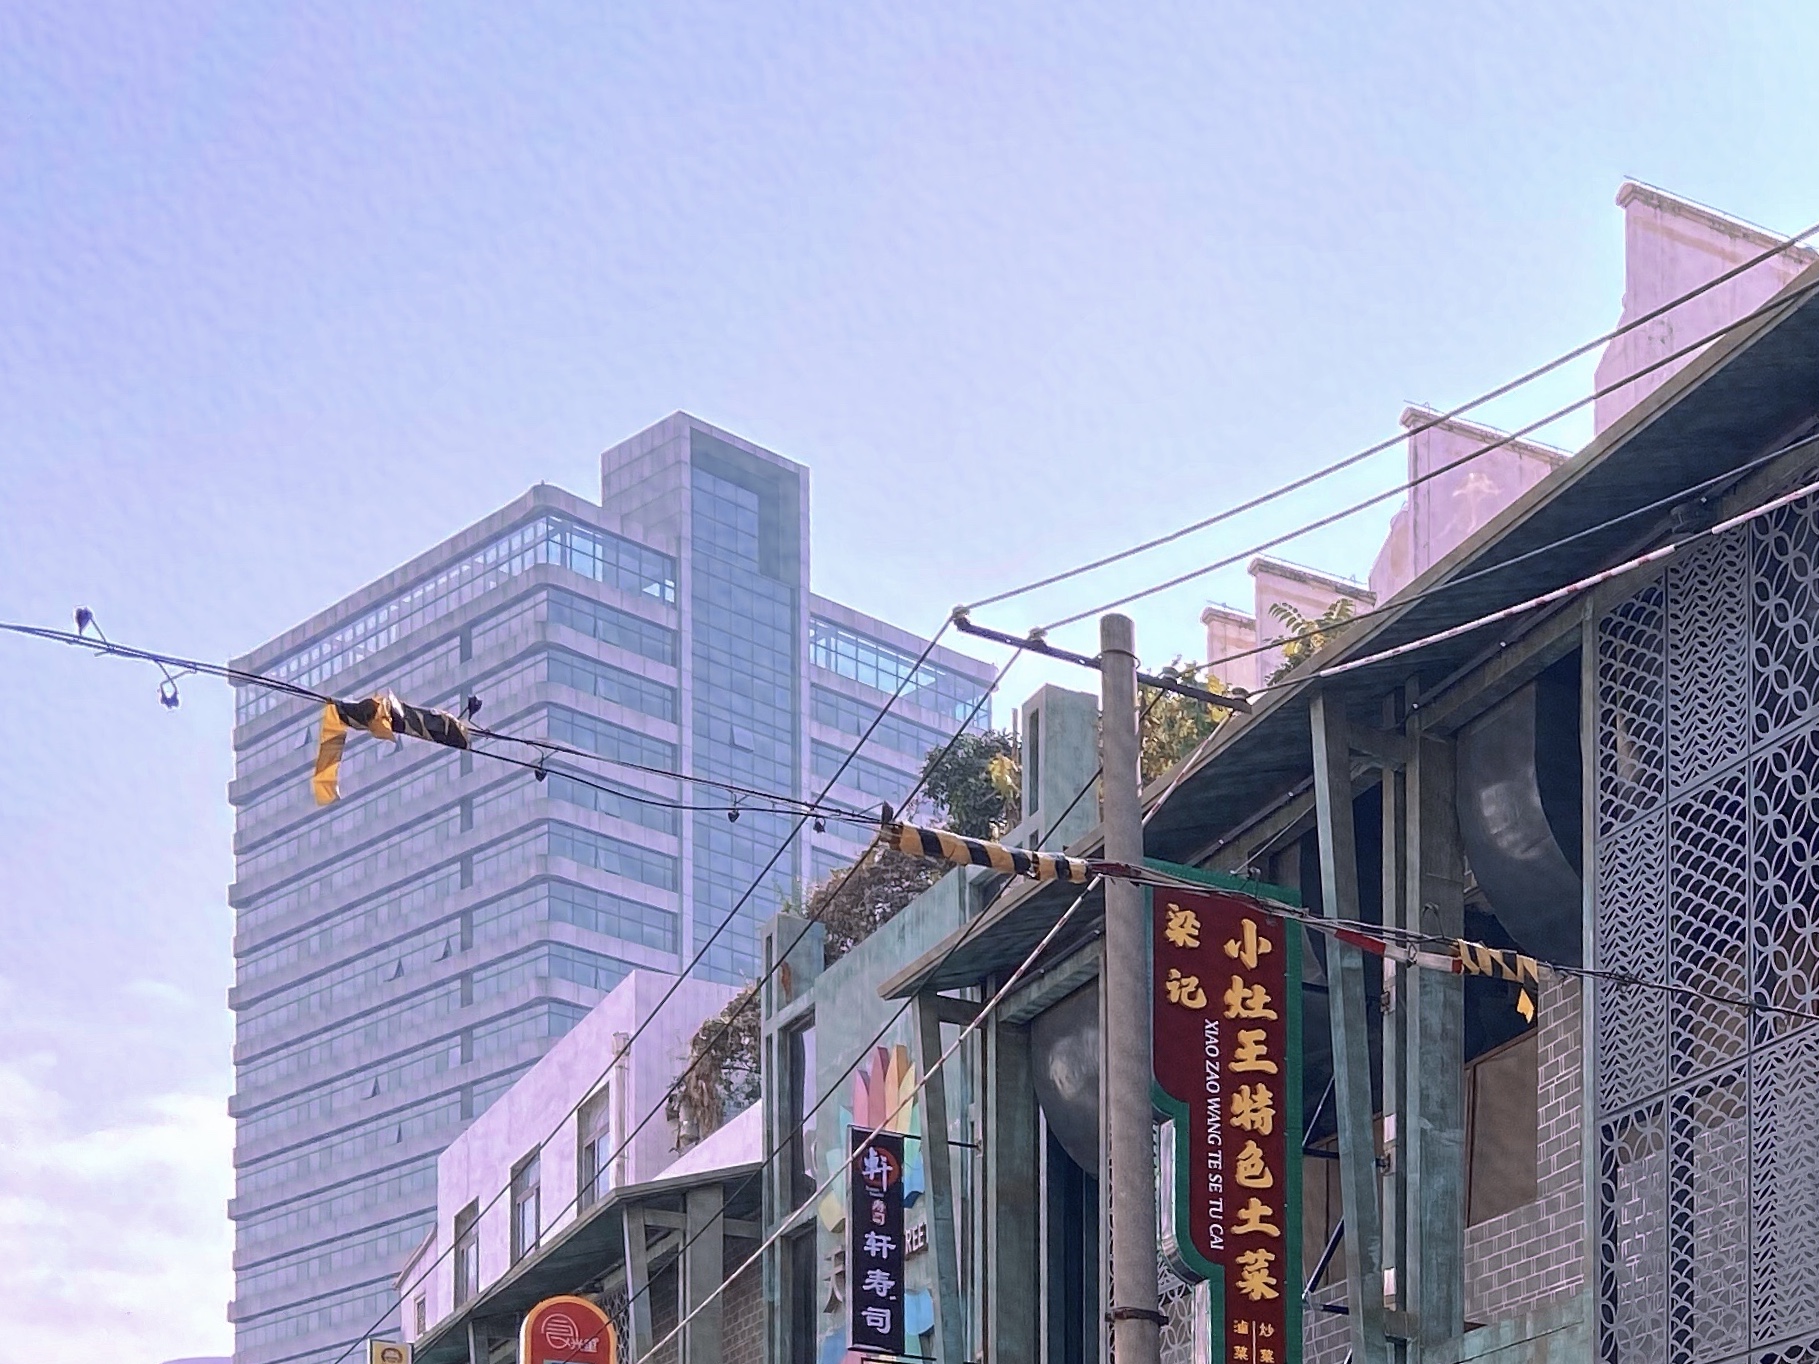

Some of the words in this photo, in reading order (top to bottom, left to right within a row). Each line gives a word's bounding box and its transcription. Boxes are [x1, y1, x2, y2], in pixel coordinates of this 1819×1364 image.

[1165, 903, 1207, 1009] 梁记
[1204, 1018, 1220, 1057] XIAO
[1205, 1061, 1221, 1094] ZAO
[1206, 1097, 1222, 1144] WANG
[1223, 918, 1280, 1300] 小灶王特色土菜
[1207, 1150, 1222, 1170] TE
[1208, 1173, 1223, 1193] SE
[1208, 1197, 1223, 1220] TU
[1209, 1223, 1224, 1250] CAI
[862, 1230, 896, 1334] 轩寿司
